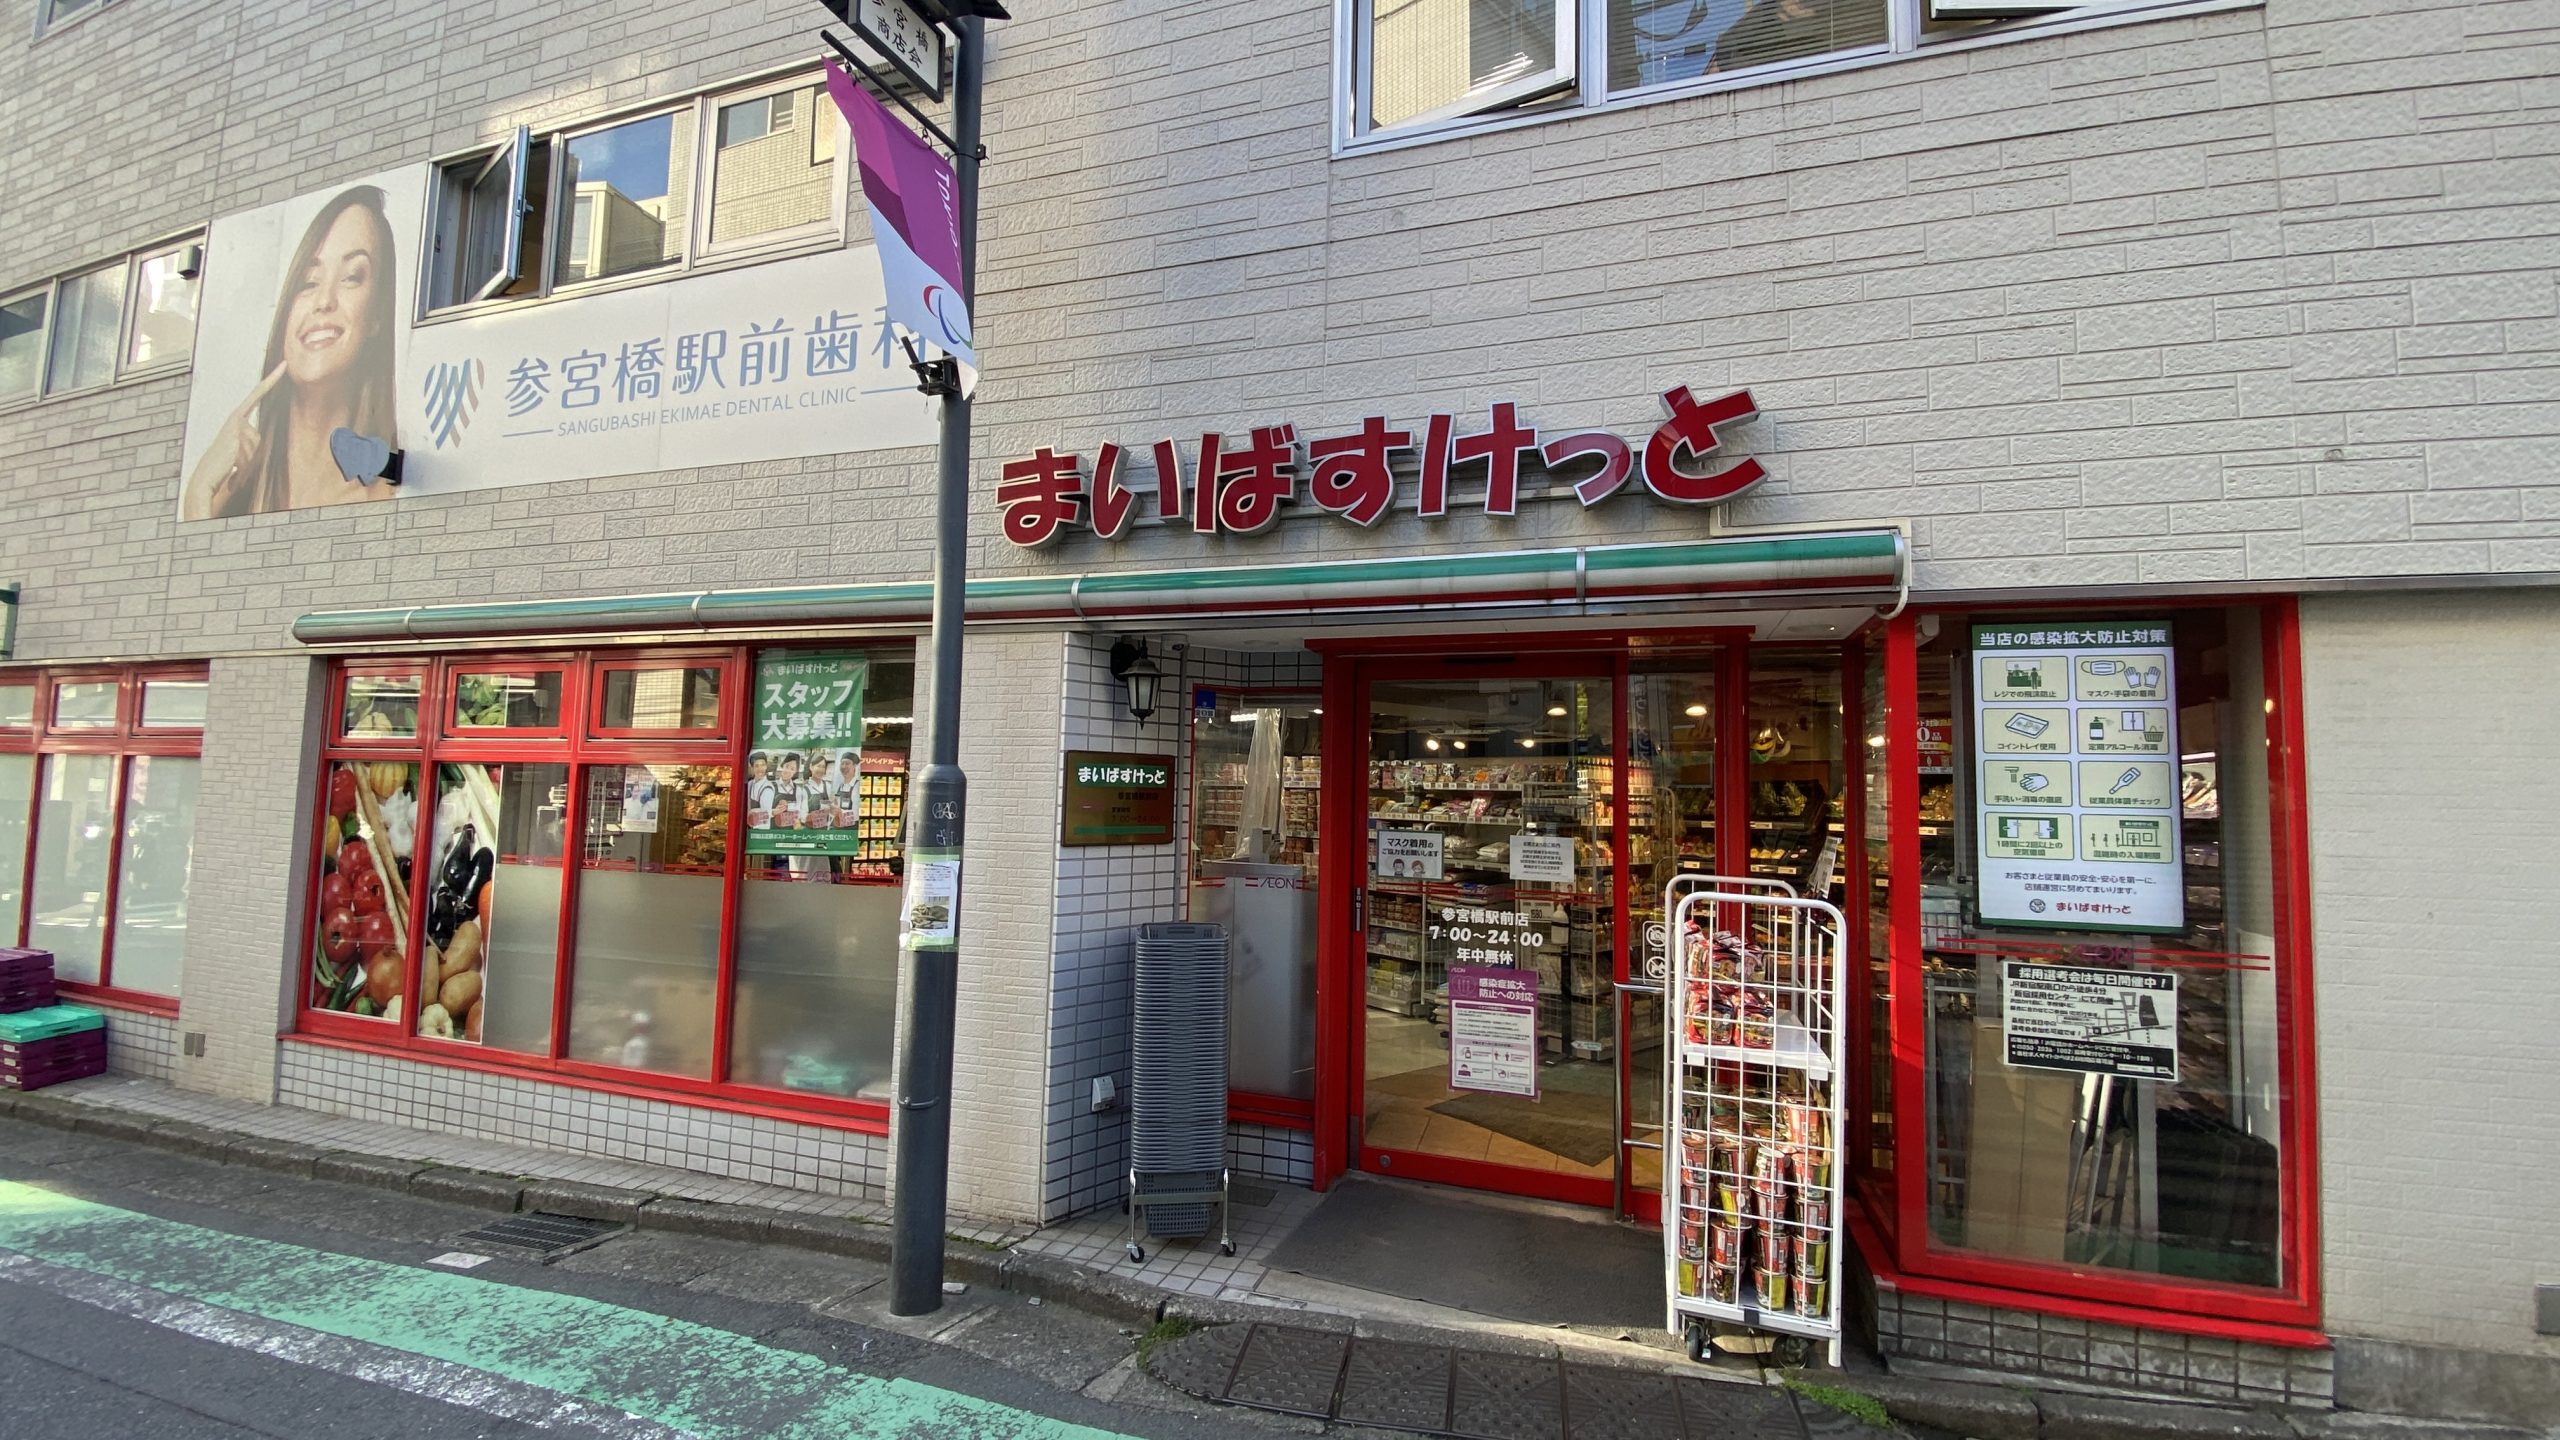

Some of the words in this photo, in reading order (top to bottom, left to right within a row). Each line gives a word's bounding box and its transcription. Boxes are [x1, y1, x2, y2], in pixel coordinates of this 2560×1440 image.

[876, 16, 922, 68] 商店会
[557, 411, 655, 437] SANGUBASHI
[661, 404, 721, 425] EKIMAE
[727, 394, 793, 417] DENTAL
[799, 386, 857, 408] CLINIC
[996, 385, 1768, 549] まいばすけっと
[1980, 629, 2166, 646] 当店の感染拡大防止対策
[777, 663, 837, 675] まいばすけっと
[763, 680, 853, 708] スタッフ
[1078, 767, 1165, 784] まいばすけっと
[1387, 838, 1434, 848] マスク着用の
[2056, 902, 2131, 914] まいばすけっと
[1441, 908, 1530, 926] 参宮橋駅前店
[1457, 948, 1514, 965] 年中無休
[1479, 978, 1526, 990] 感染症拡大
[1479, 989, 1534, 1002] 防止への対応
